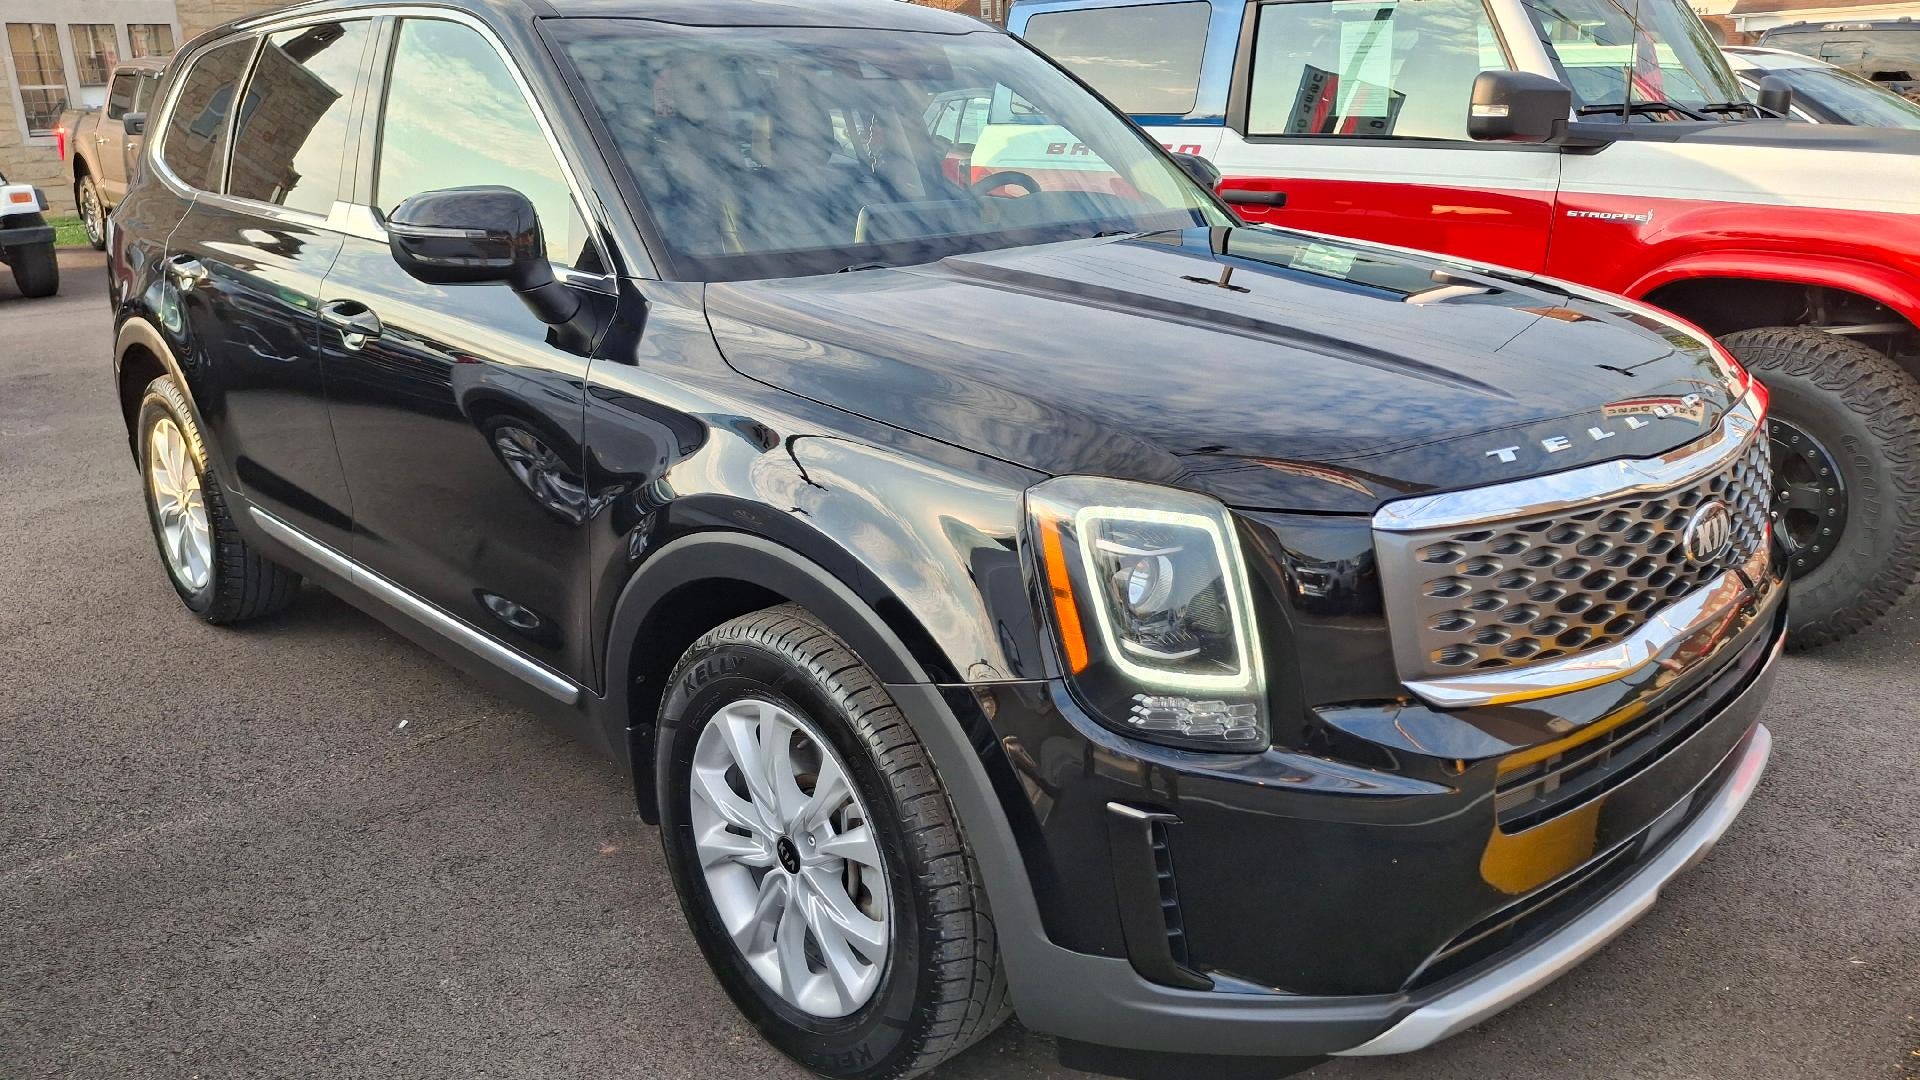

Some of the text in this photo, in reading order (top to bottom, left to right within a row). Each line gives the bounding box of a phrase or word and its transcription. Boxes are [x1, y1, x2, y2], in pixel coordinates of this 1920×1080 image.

[1567, 210, 1648, 222] STROPPE
[1696, 511, 1729, 557] KIA
[683, 655, 747, 697] KELLY
[779, 841, 796, 871] KIA
